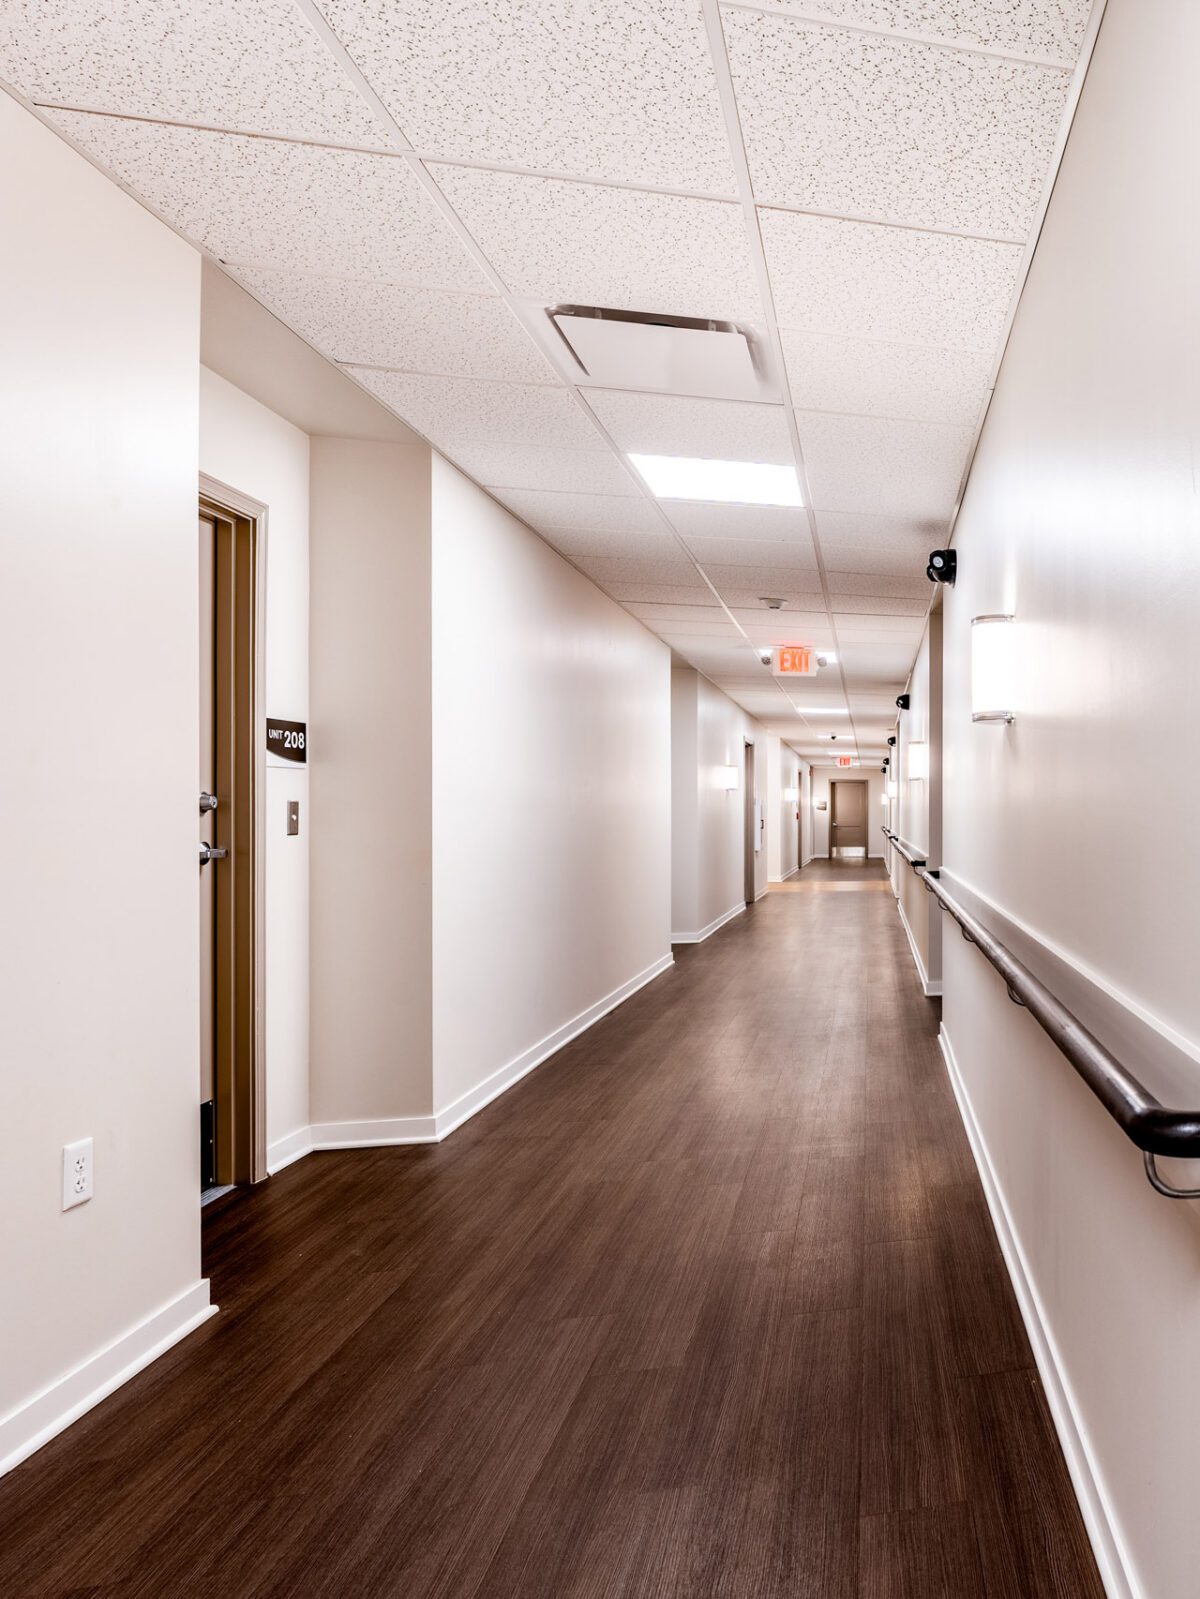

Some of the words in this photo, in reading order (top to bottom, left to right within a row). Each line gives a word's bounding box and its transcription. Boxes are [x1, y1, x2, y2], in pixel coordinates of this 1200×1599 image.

[779, 650, 811, 672] EXIT
[268, 729, 283, 740] UNIT
[284, 730, 305, 749] 208
